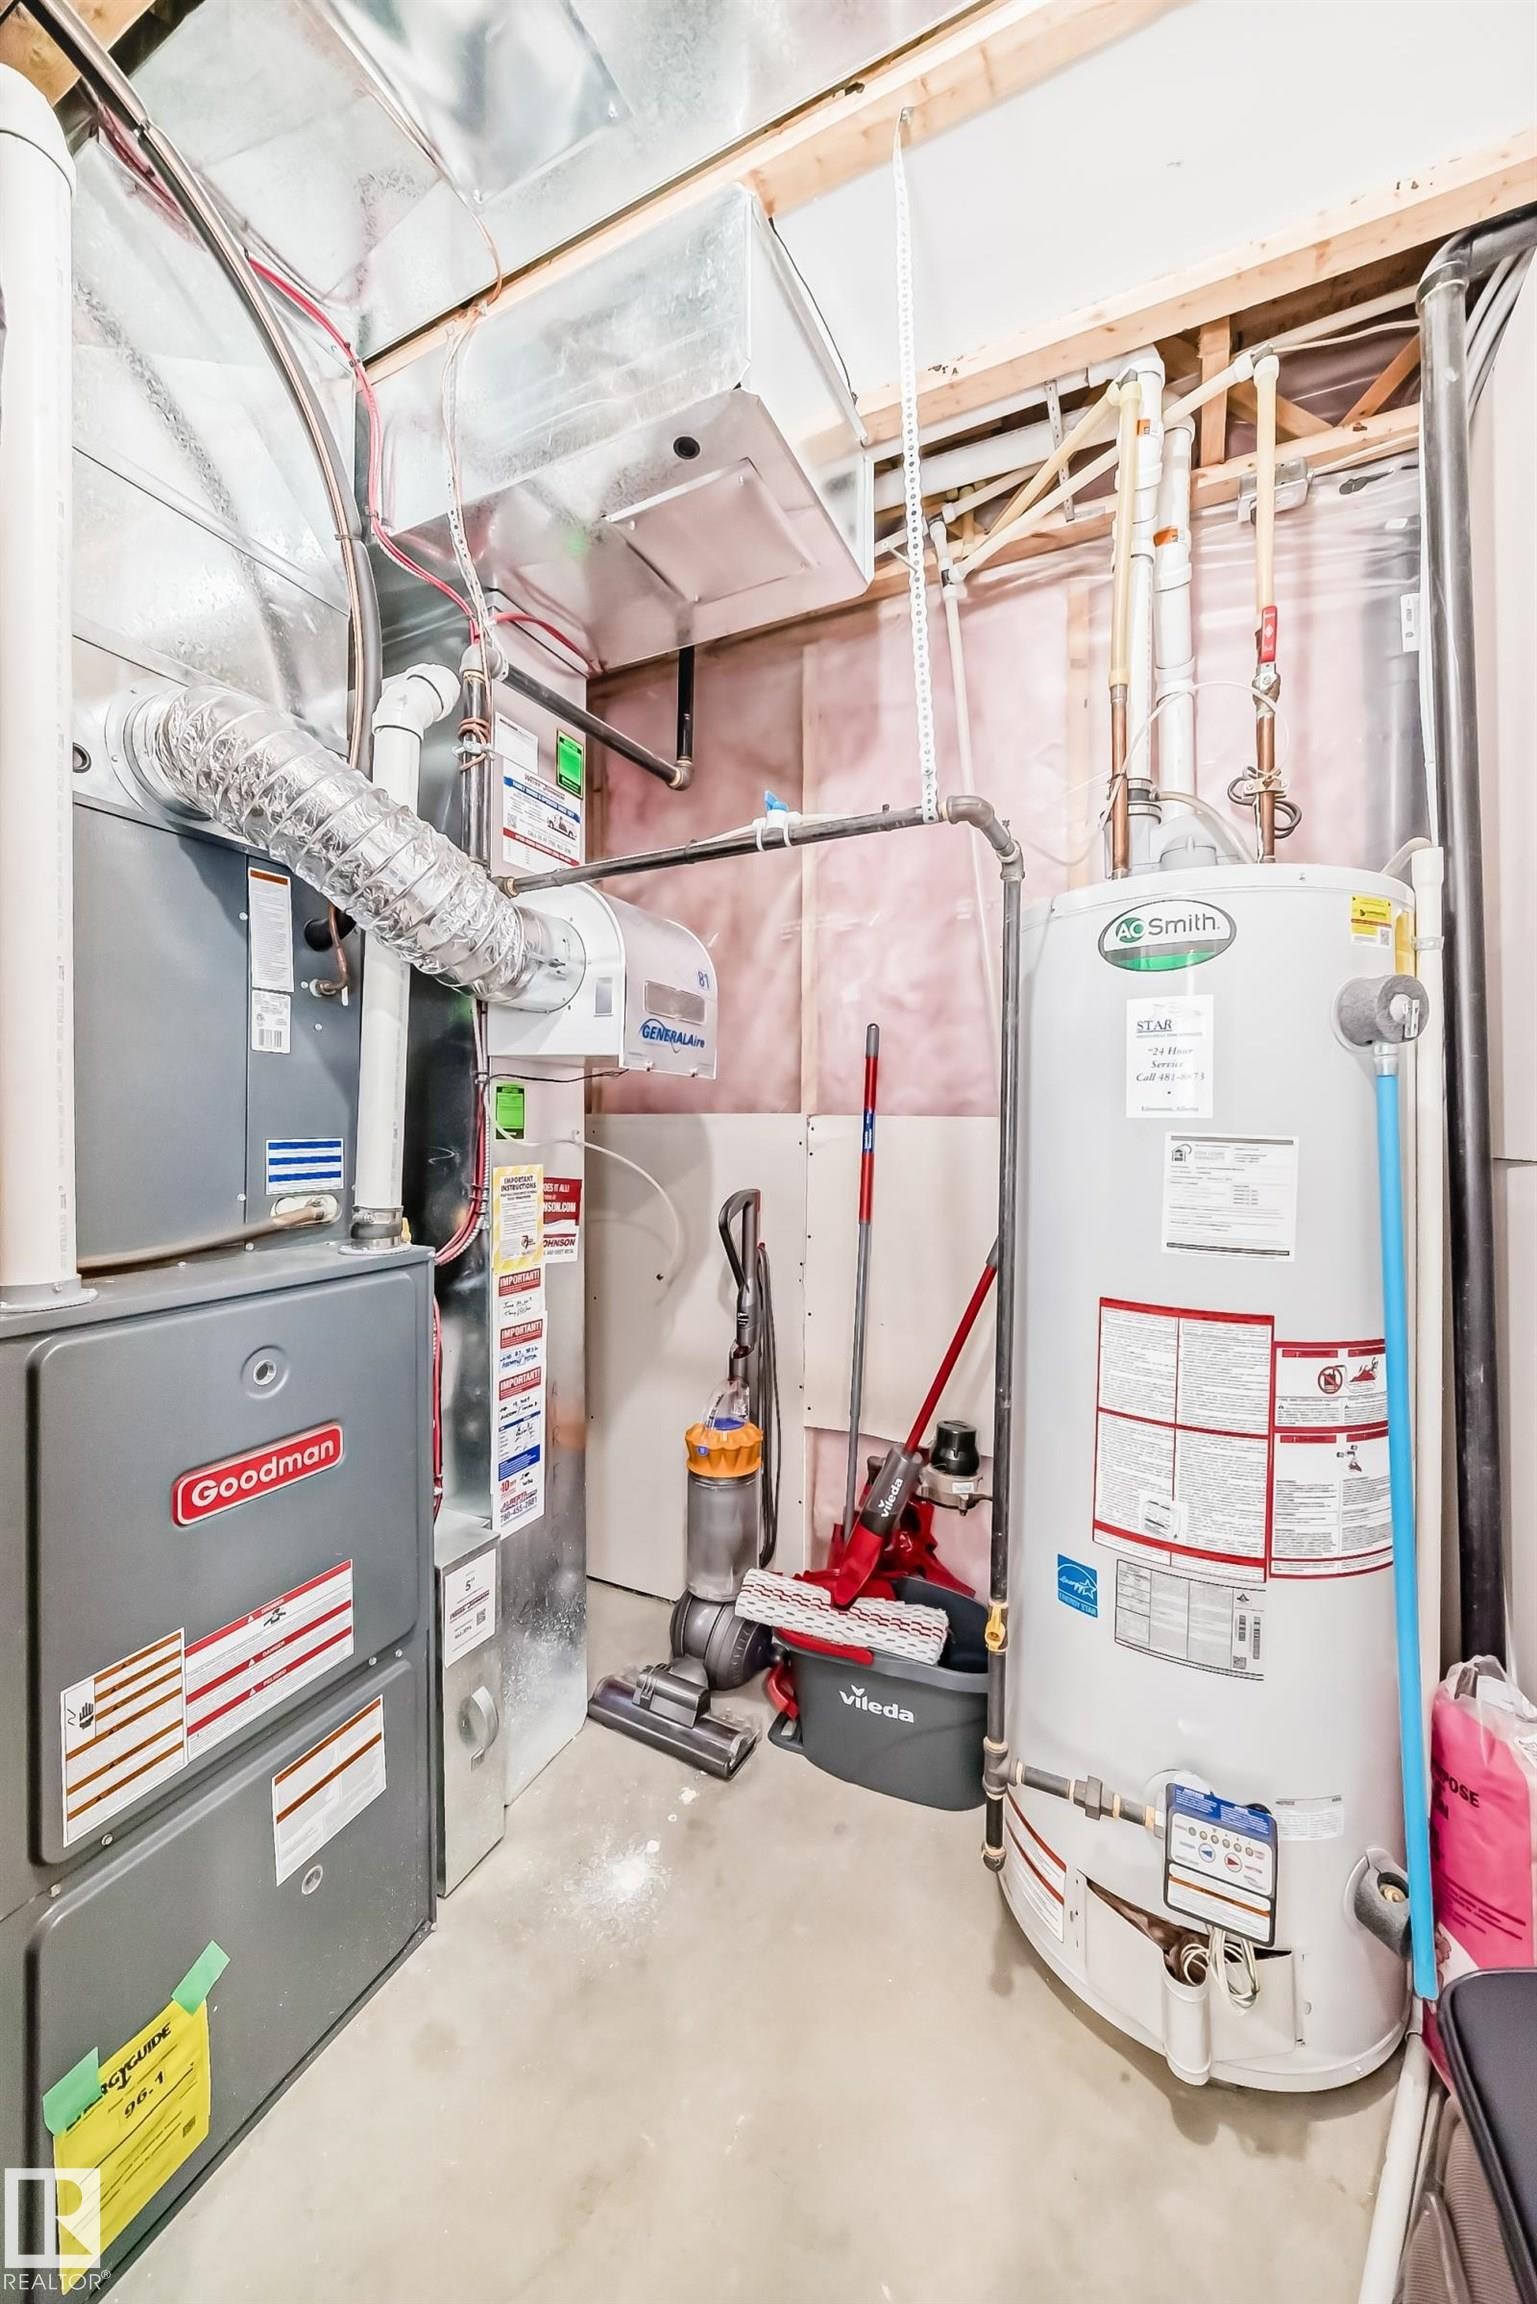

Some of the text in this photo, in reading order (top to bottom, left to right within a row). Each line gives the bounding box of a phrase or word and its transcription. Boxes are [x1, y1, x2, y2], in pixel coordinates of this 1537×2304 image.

[1116, 913, 1217, 940] AO Smith
[1136, 1018, 1173, 1032] STAR
[1136, 1072, 1156, 1081] Call
[501, 1183, 537, 1192] INSTRUCTIONS
[503, 1175, 534, 1185] IMPORTANT
[543, 1183, 553, 1192] OES
[543, 1202, 576, 1213] NSON.COM
[543, 1239, 576, 1248] OHNSON
[500, 1270, 540, 1287] IMPORTANT!
[501, 1321, 543, 1339] IMPORTANT!
[500, 1368, 540, 1390] IMPORTANT!
[191, 1436, 334, 1509] Goodman
[880, 1477, 904, 1519] vileda
[839, 1684, 915, 1724] vileda
[124, 2071, 165, 2119] 96.1
